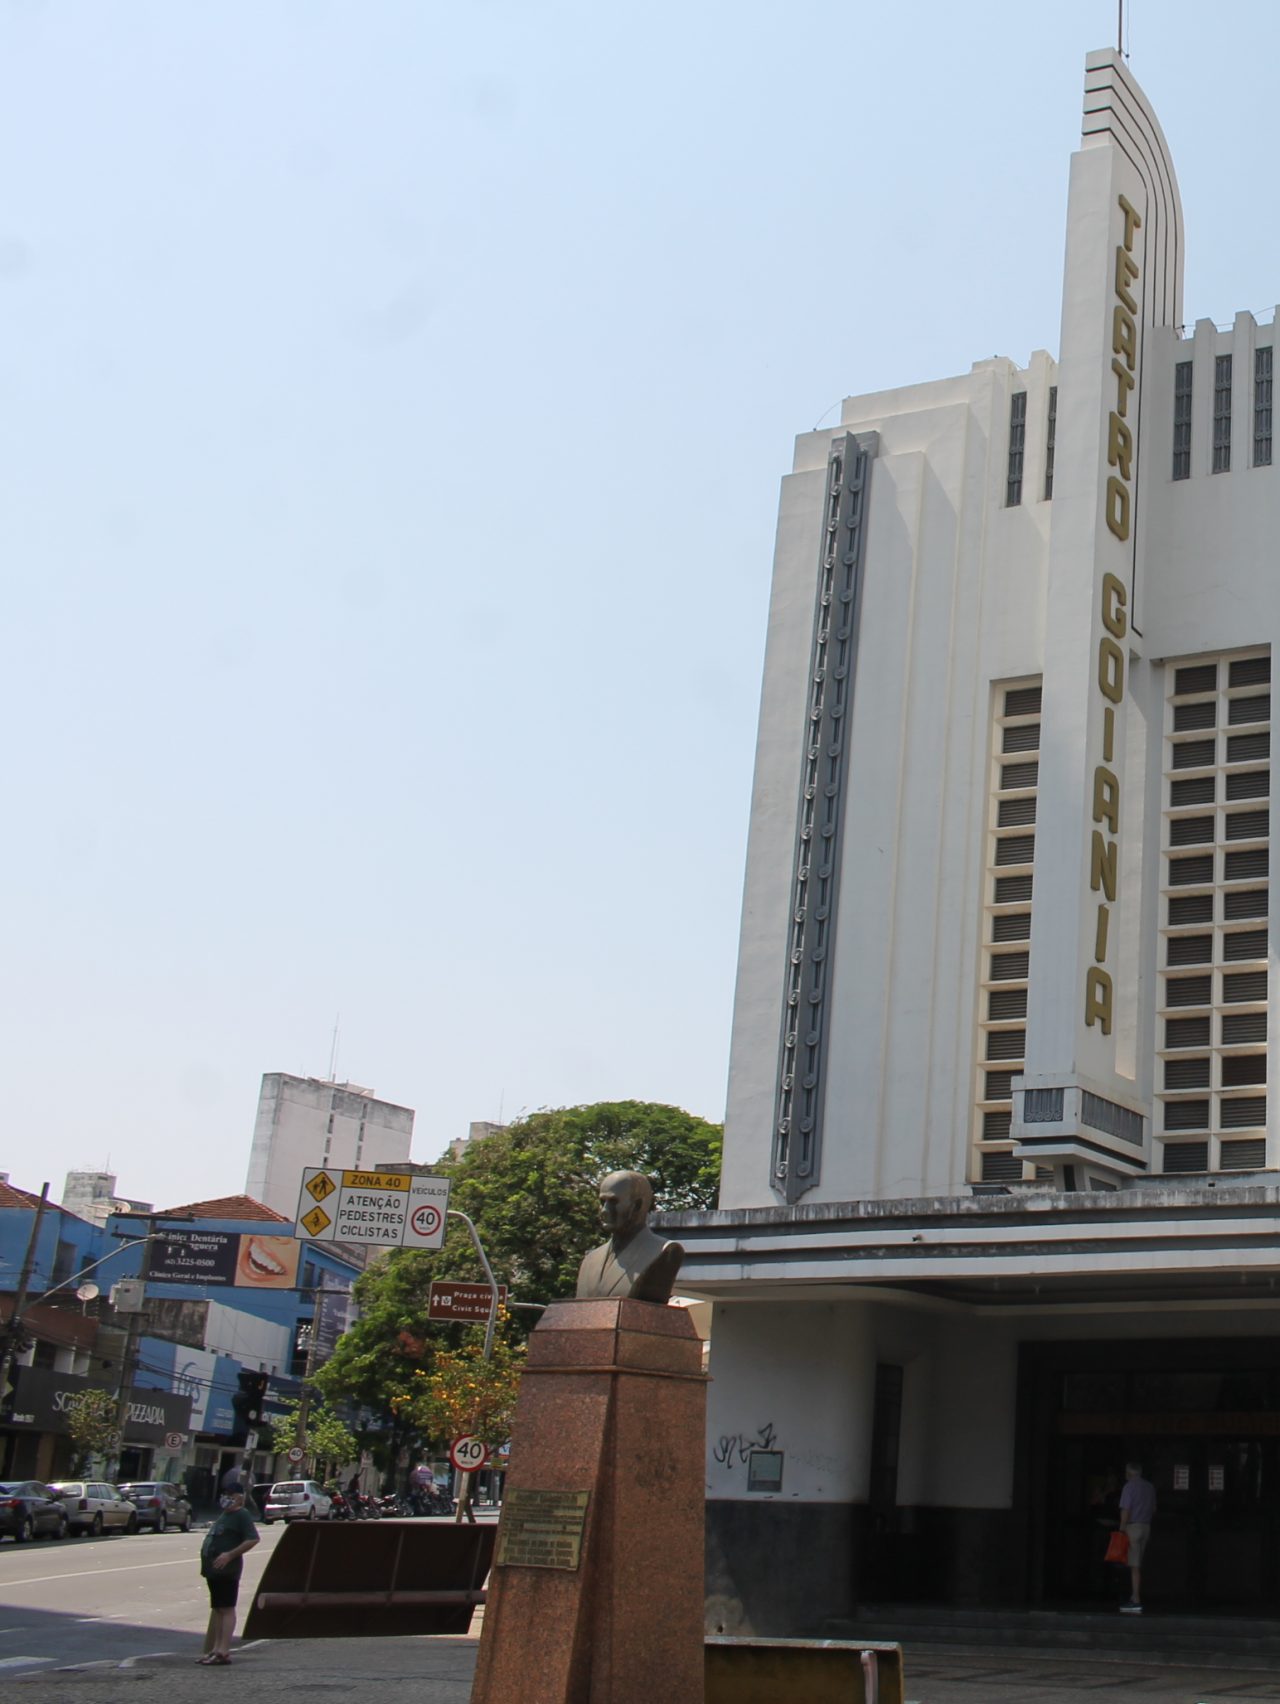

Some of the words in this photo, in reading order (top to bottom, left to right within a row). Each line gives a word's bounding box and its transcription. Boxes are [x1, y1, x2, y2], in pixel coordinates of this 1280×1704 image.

[1105, 193, 1142, 542] TEATRO
[1084, 571, 1127, 1036] GOIANIA
[351, 1174, 382, 1187] ZONA
[385, 1177, 401, 1188] 40
[346, 1195, 401, 1210] ATENÇÃO
[339, 1209, 404, 1225] PEDESTRES
[416, 1212, 435, 1226] 40
[190, 1233, 228, 1244] Dentária
[340, 1224, 398, 1239] CICLISTAS
[125, 1402, 166, 1426] PIZZARIA
[291, 1449, 300, 1457] 40
[457, 1442, 482, 1459] 40
